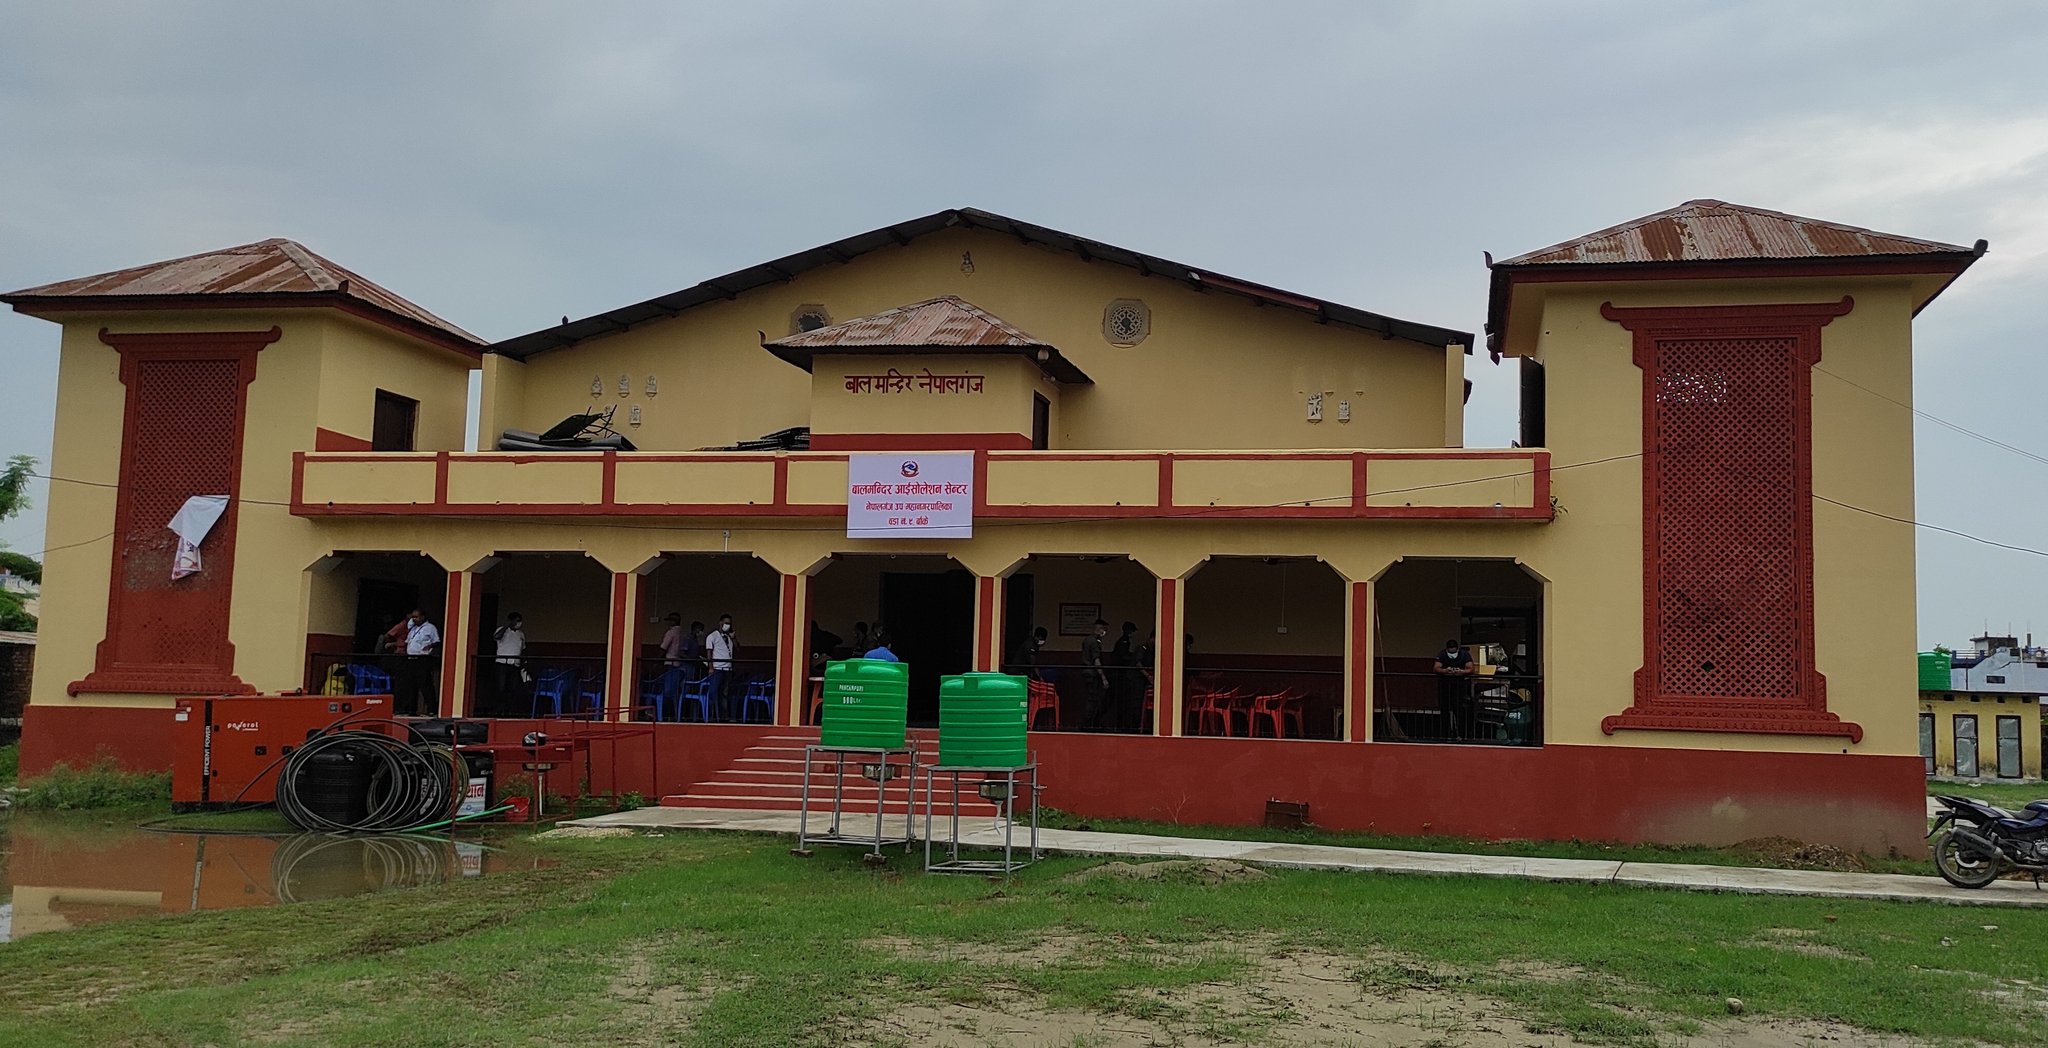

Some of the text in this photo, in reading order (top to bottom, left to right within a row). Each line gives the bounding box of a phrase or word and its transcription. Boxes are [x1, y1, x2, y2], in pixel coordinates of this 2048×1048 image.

[844, 367, 985, 394] बाल मन्दिर नेपालगंज
[895, 481, 942, 495] आईसोलेशन
[944, 481, 968, 495] सेन्टर
[895, 503, 904, 511] उप
[905, 500, 952, 511] महानगरपालिका
[888, 517, 899, 526] वडा
[203, 725, 212, 776] EFFICIENT POWER
